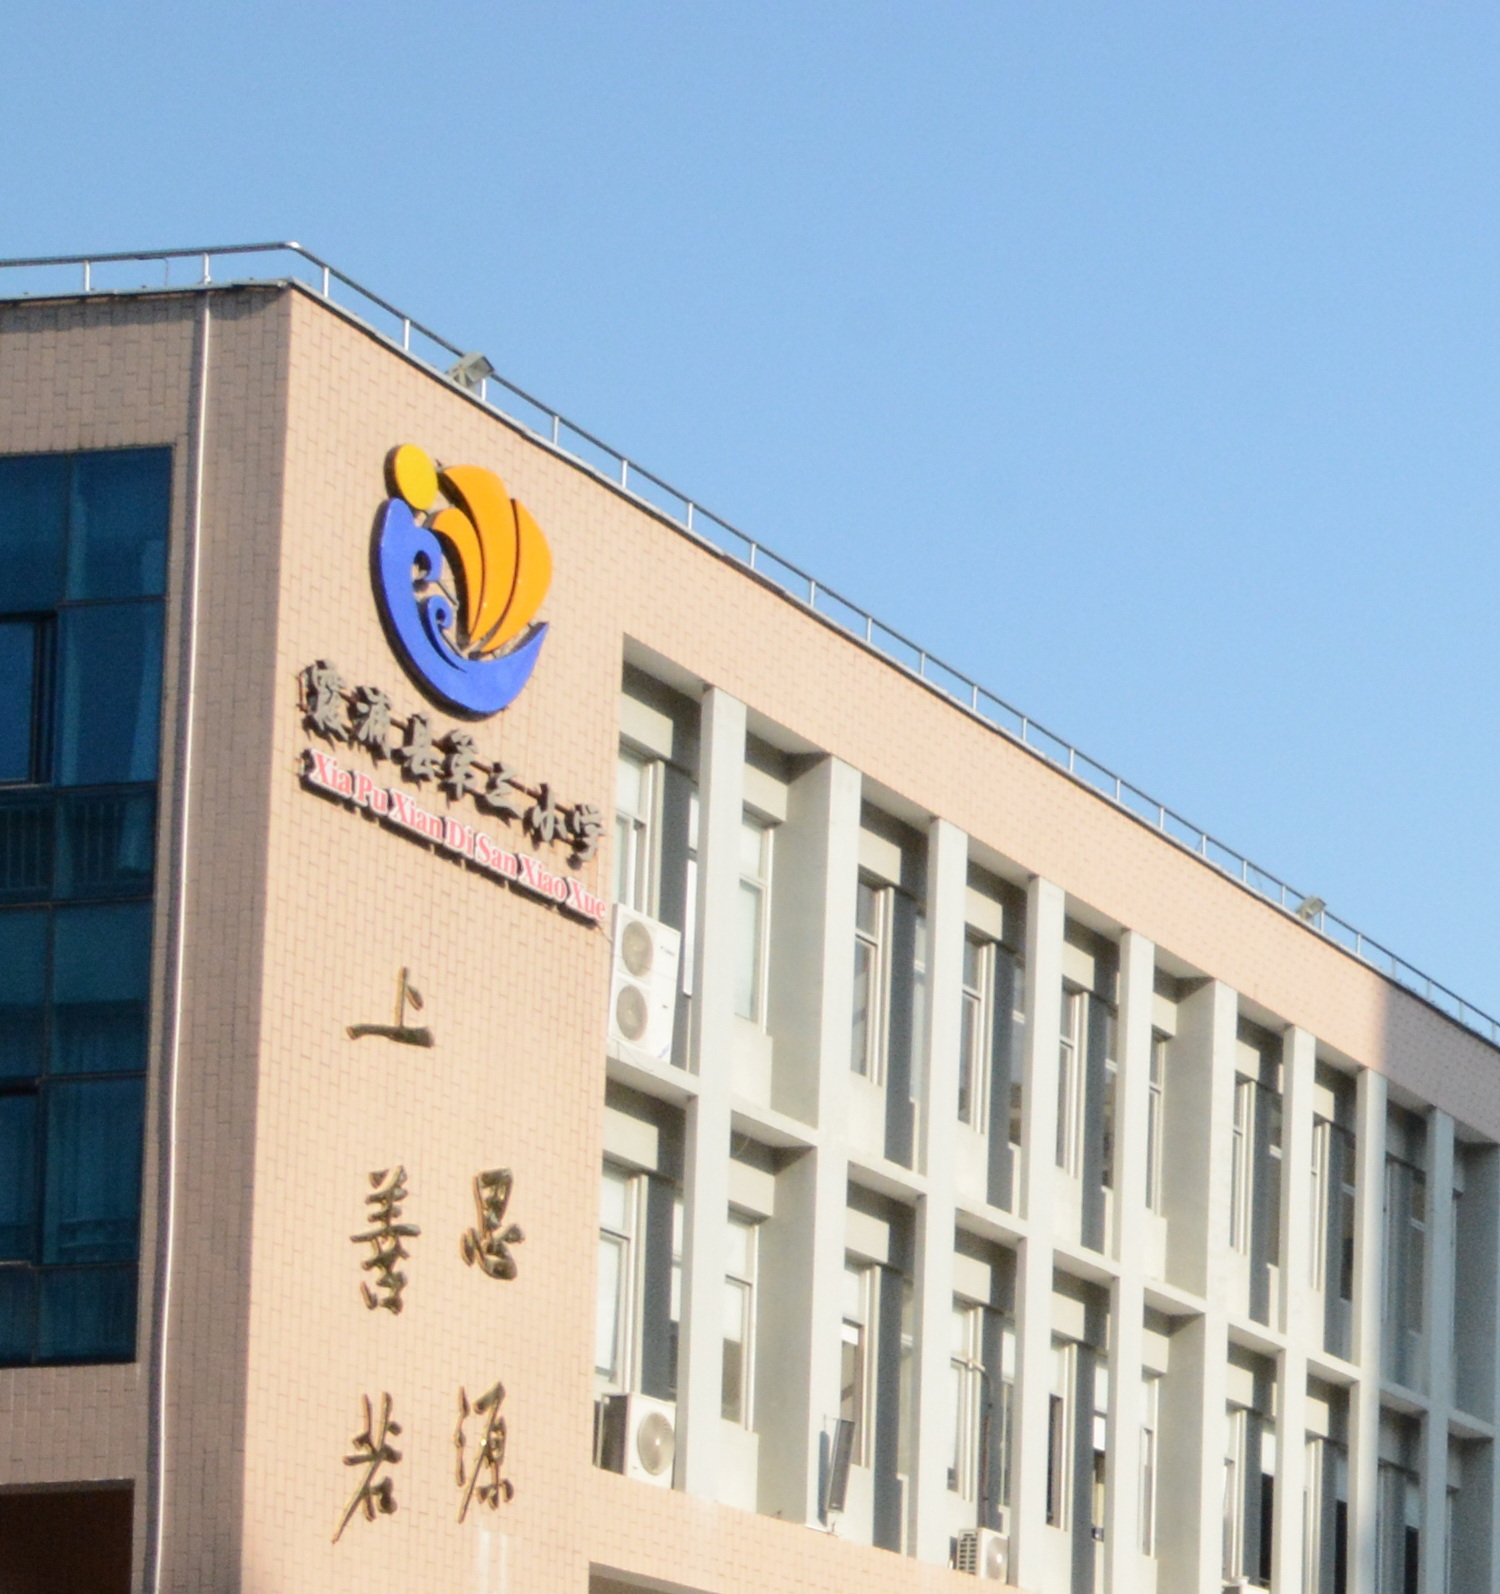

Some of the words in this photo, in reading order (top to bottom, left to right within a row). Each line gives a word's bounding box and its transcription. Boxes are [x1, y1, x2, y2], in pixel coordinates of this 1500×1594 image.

[306, 659, 603, 863] 霞浦县第三小学
[311, 751, 353, 797] Xia
[356, 772, 389, 814] Pu
[391, 790, 443, 841] Xian
[446, 818, 474, 858] Di
[475, 834, 518, 879] San
[519, 856, 568, 900] Xiao
[567, 879, 606, 920] Xue
